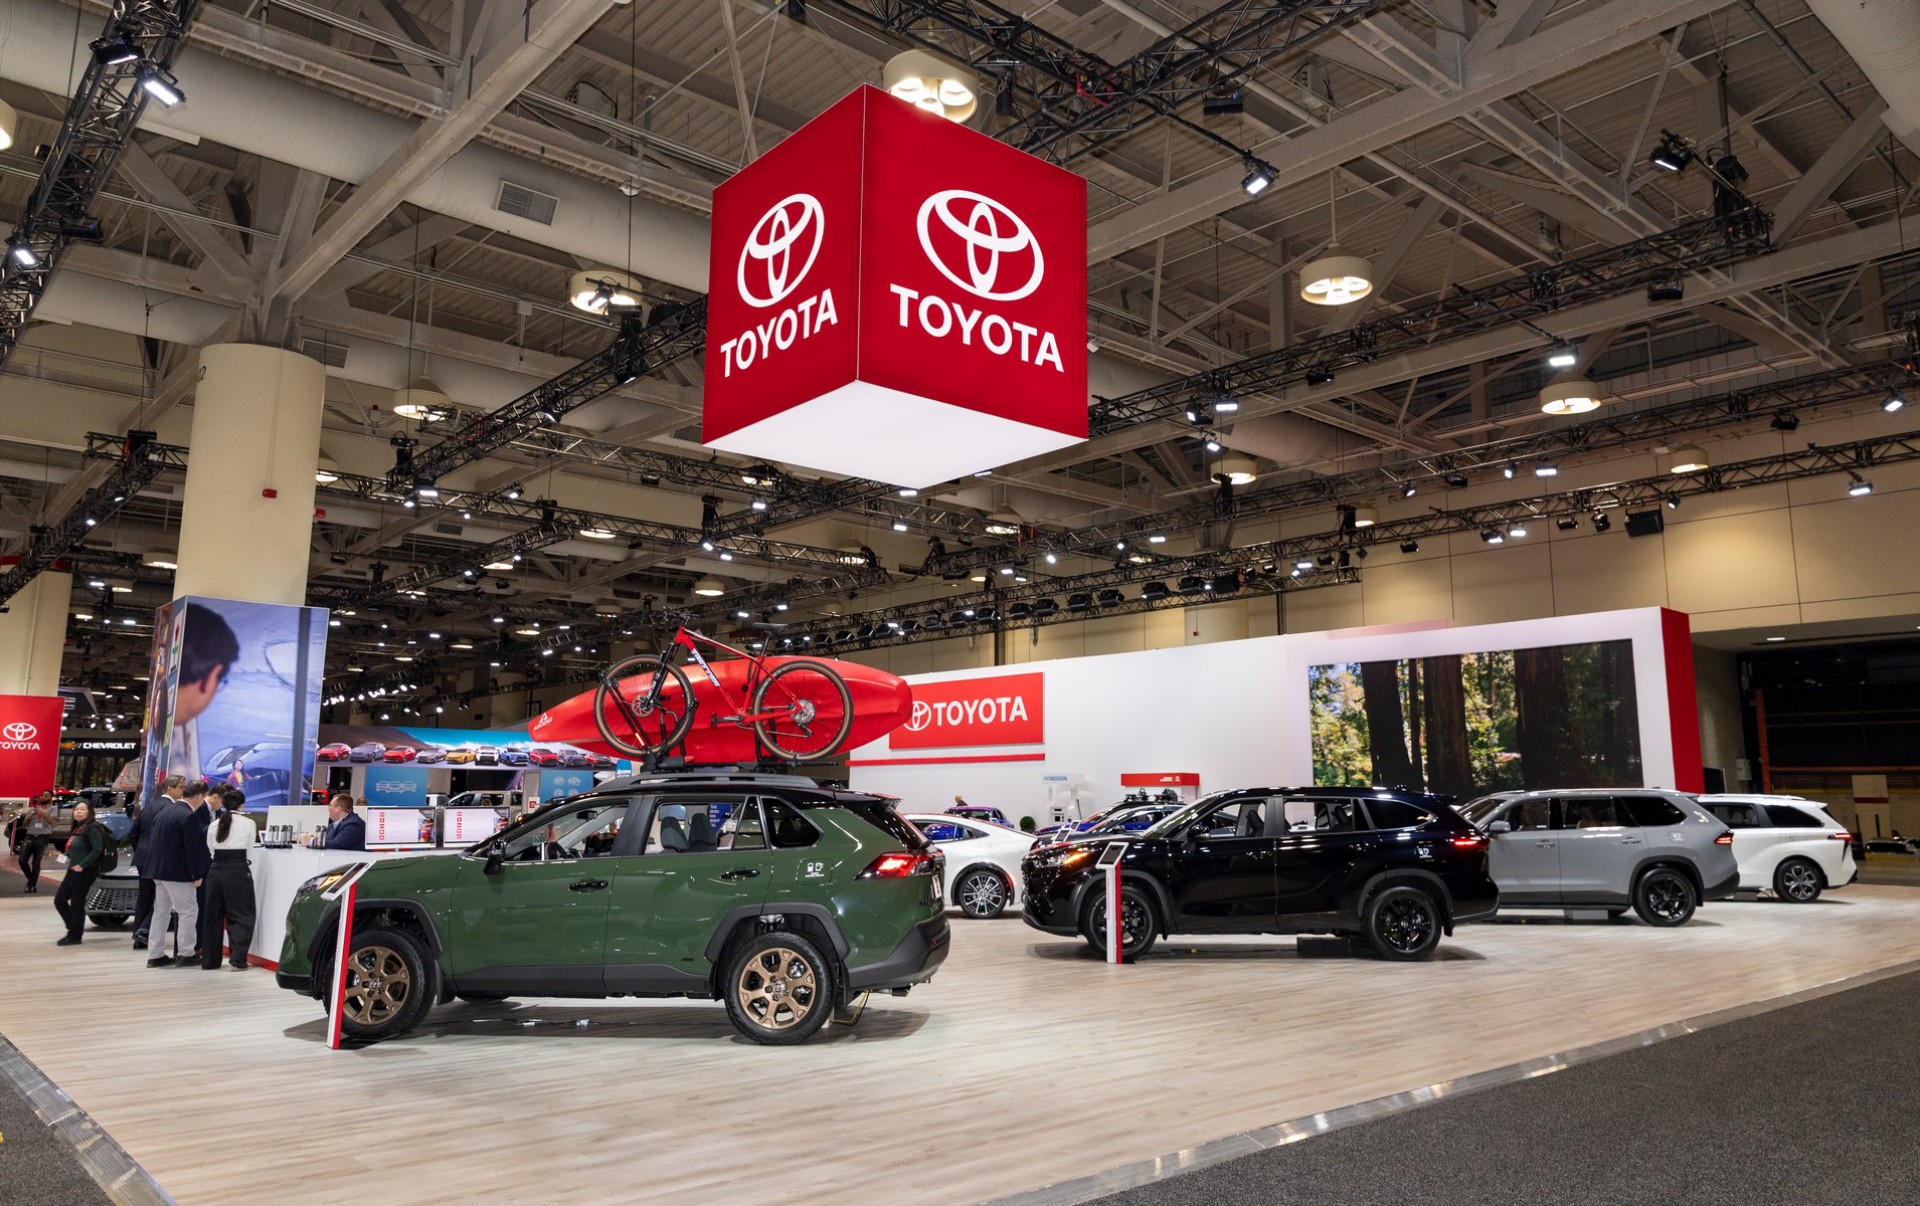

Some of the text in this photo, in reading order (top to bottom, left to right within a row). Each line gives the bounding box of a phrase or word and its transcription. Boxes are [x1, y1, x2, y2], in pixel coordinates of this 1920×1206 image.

[720, 288, 838, 378] TOYOTA
[890, 284, 1064, 373] TOYOTA
[933, 696, 1028, 726] TOYOTA
